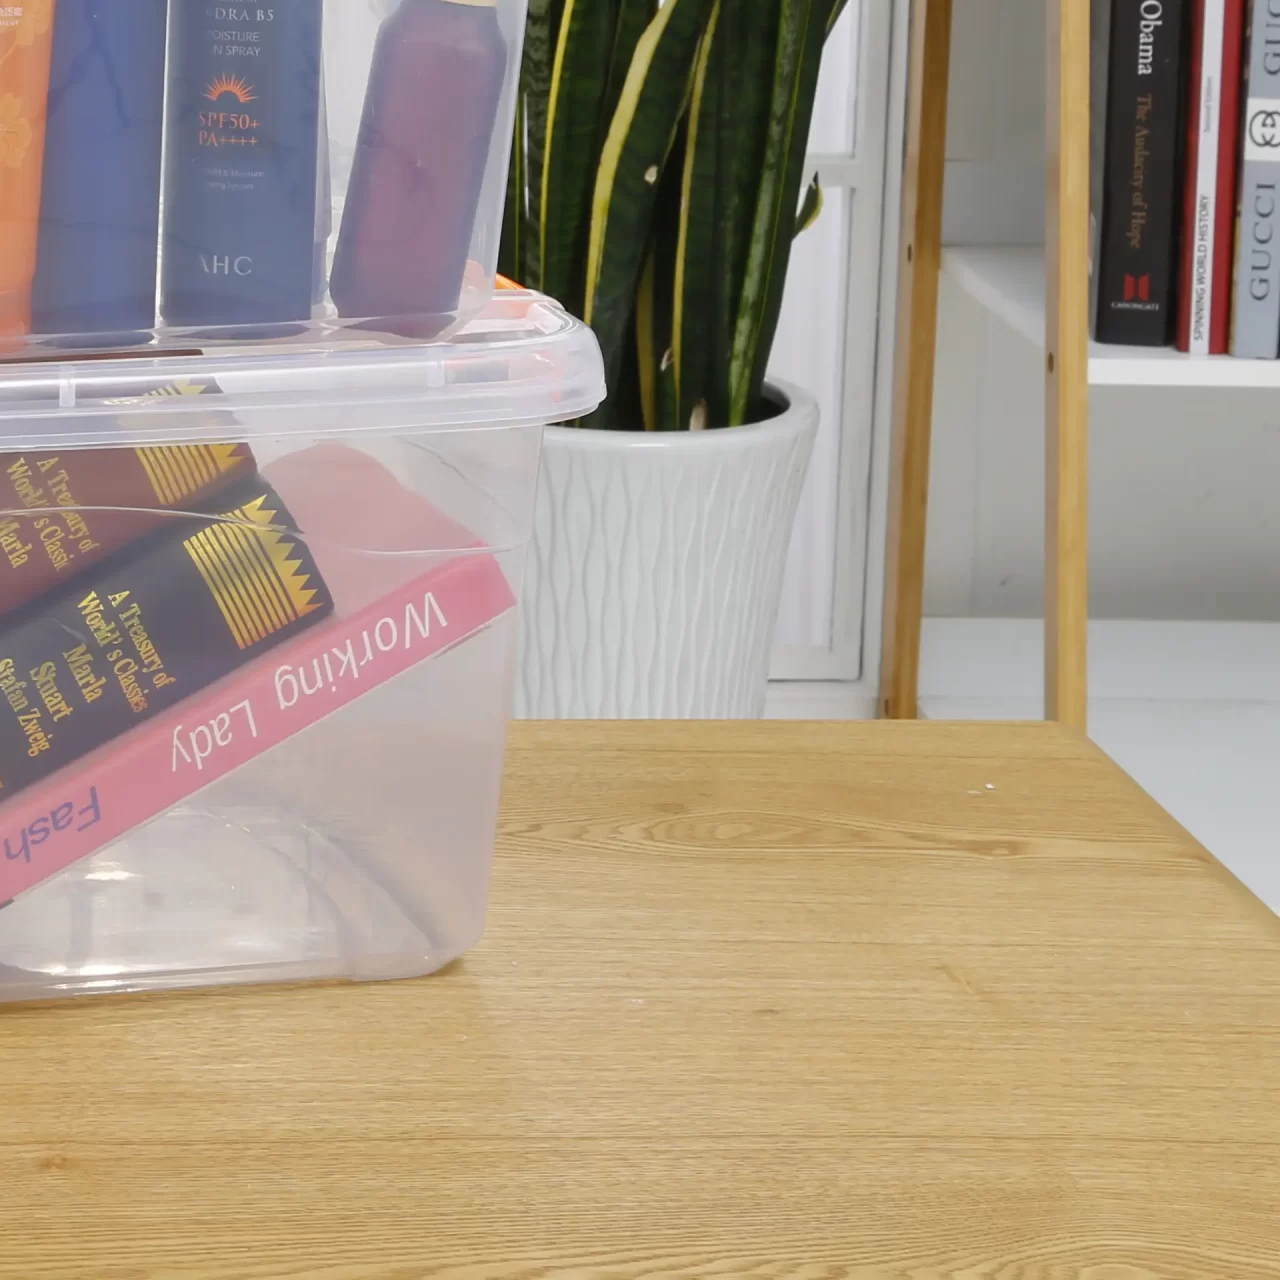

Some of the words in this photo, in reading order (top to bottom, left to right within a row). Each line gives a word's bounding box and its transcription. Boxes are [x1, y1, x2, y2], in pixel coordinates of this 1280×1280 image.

[208, 29, 260, 42] OISTURE
[256, 8, 274, 22] B5
[1138, 0, 1163, 75] Obama
[225, 45, 261, 57] SPRAY
[199, 111, 260, 129] SPF50+
[199, 130, 258, 147] PA++++
[1132, 191, 1147, 208] of
[1199, 195, 1210, 242] HISTORY
[1196, 243, 1208, 286] WORLD
[1249, 183, 1275, 302] GUCCI
[36, 457, 58, 473] A
[78, 538, 100, 554] of
[107, 590, 130, 608] A
[119, 603, 164, 673] Treasury
[152, 672, 176, 689] of
[273, 591, 448, 710] Working
[29, 661, 73, 723] Stuart
[62, 642, 107, 704] Marla
[17, 707, 53, 757] Zweig
[171, 699, 258, 772] Lady
